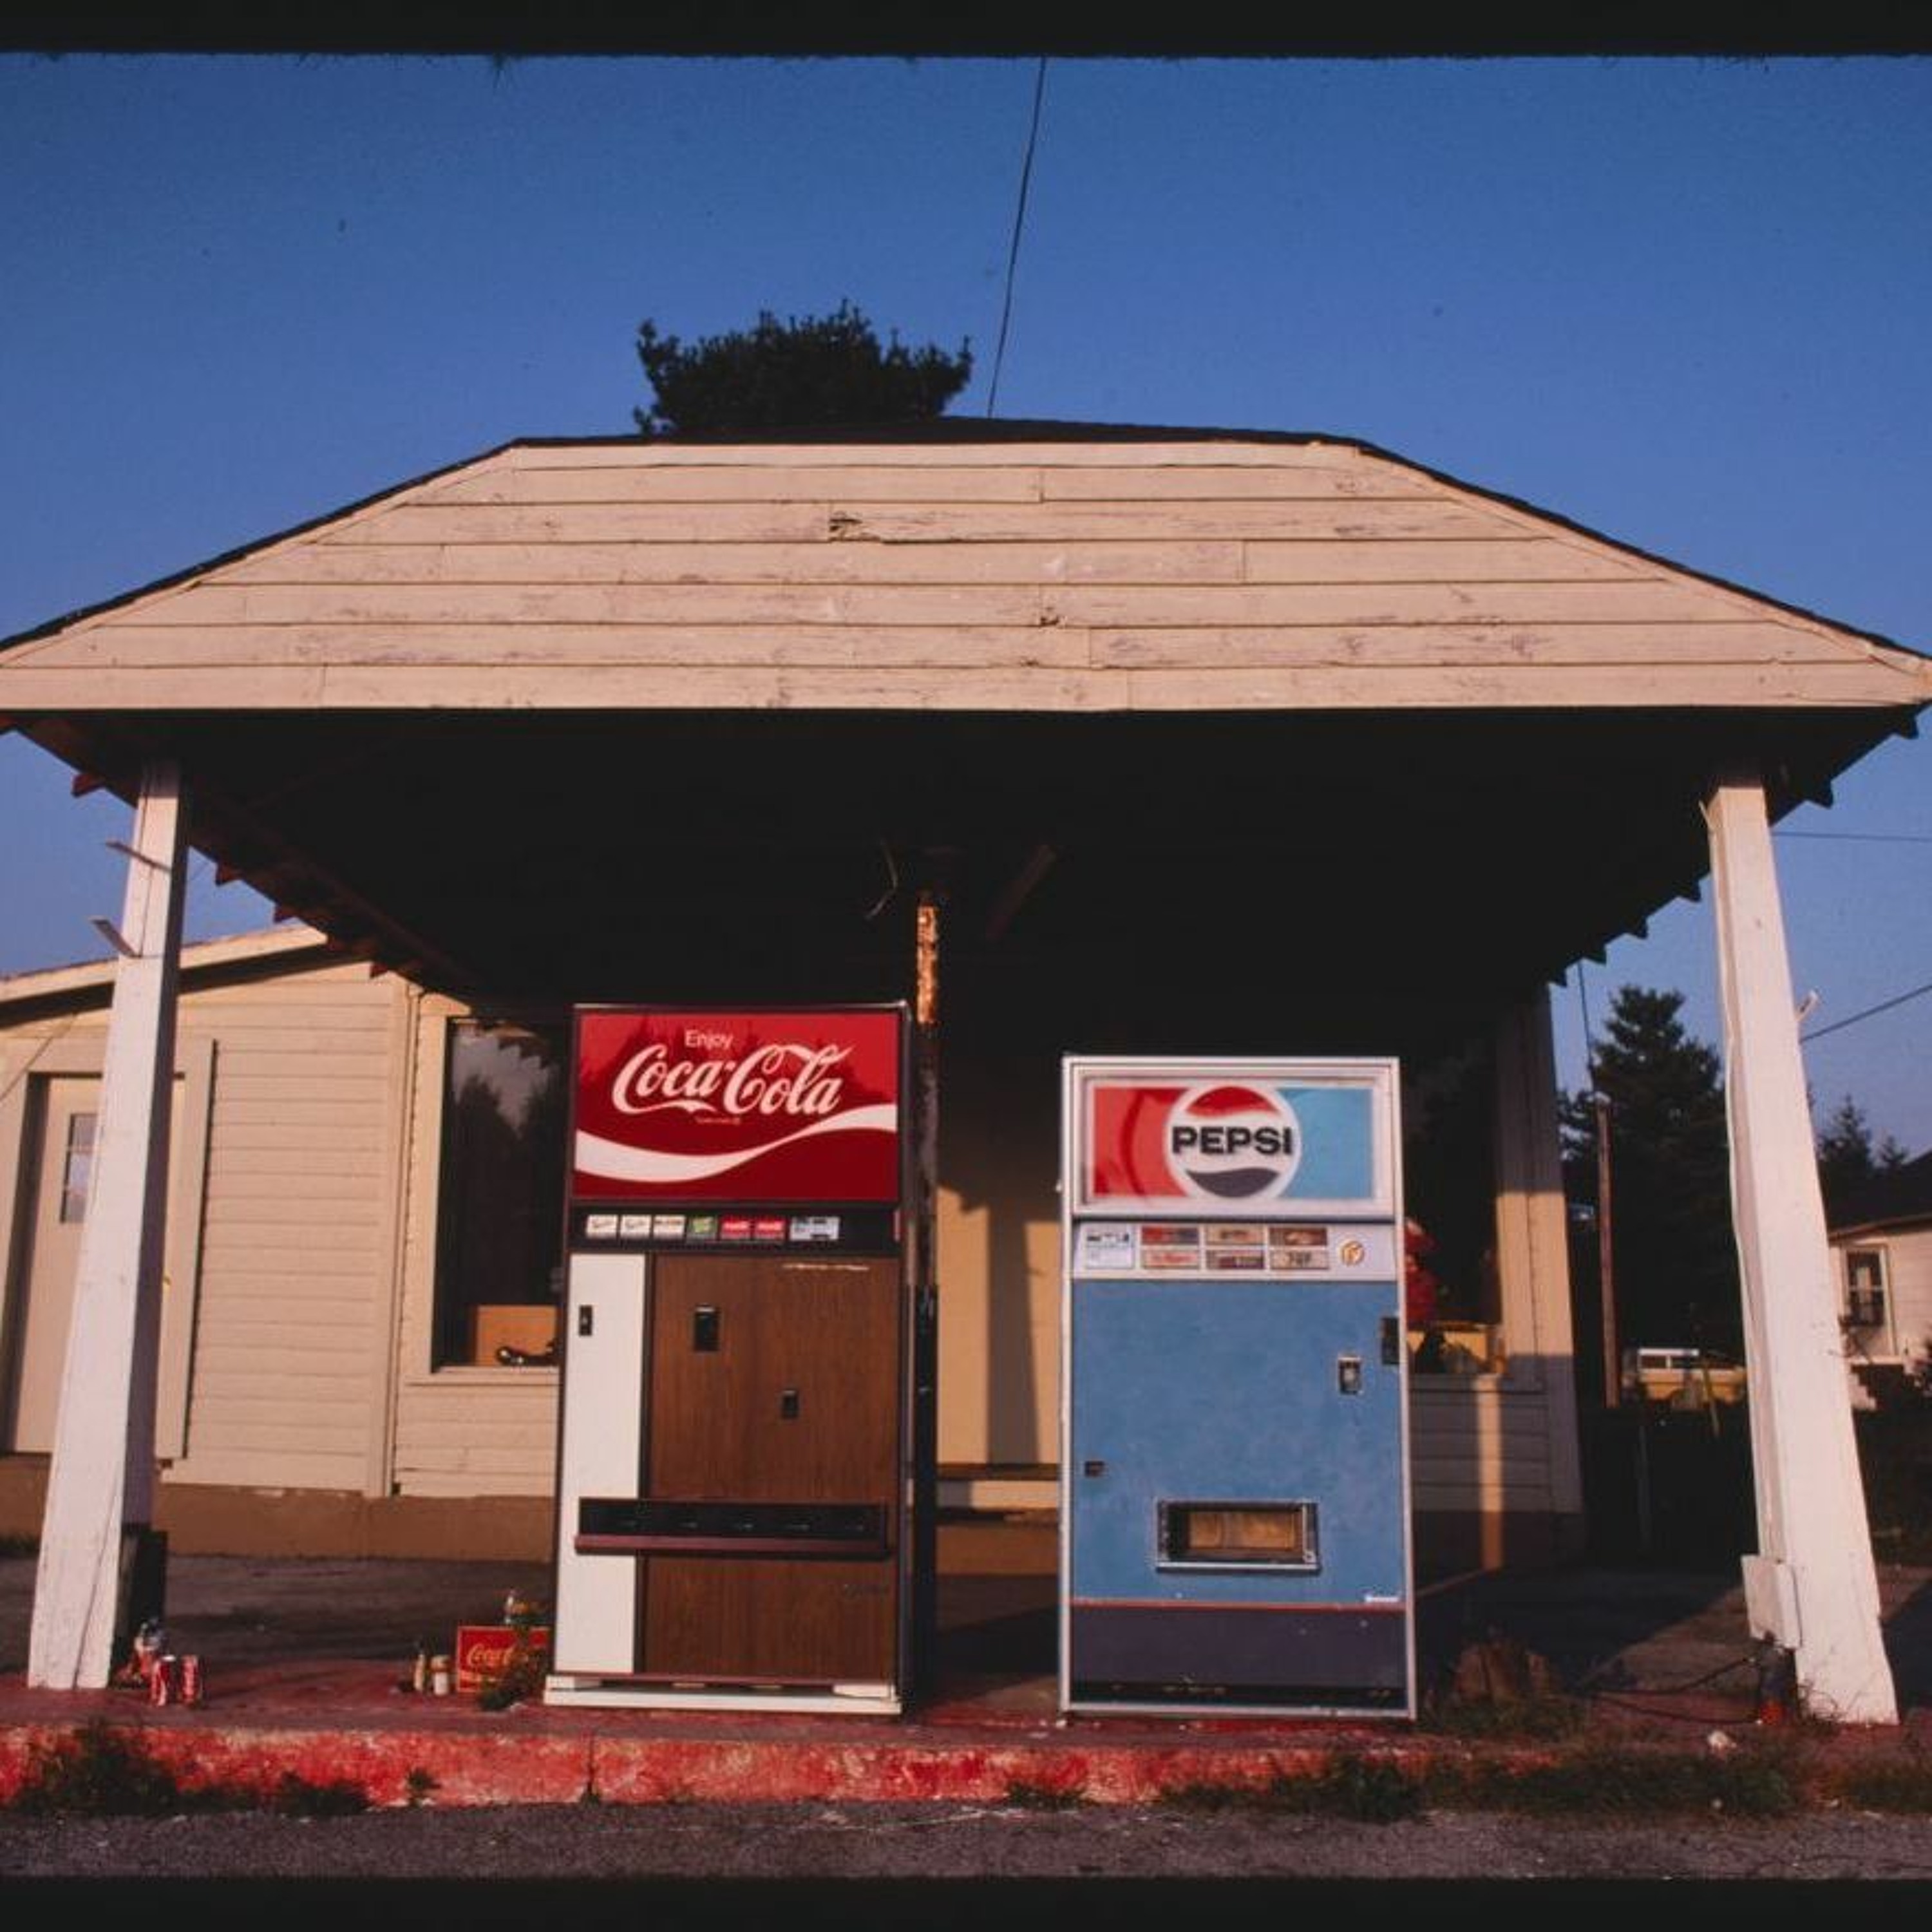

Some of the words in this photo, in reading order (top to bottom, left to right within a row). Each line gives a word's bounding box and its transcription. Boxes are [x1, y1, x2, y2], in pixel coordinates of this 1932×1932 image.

[685, 1030, 733, 1050] Enjoy
[612, 1044, 855, 1115] Coca-Cola
[1172, 1126, 1293, 1155] PEPSI
